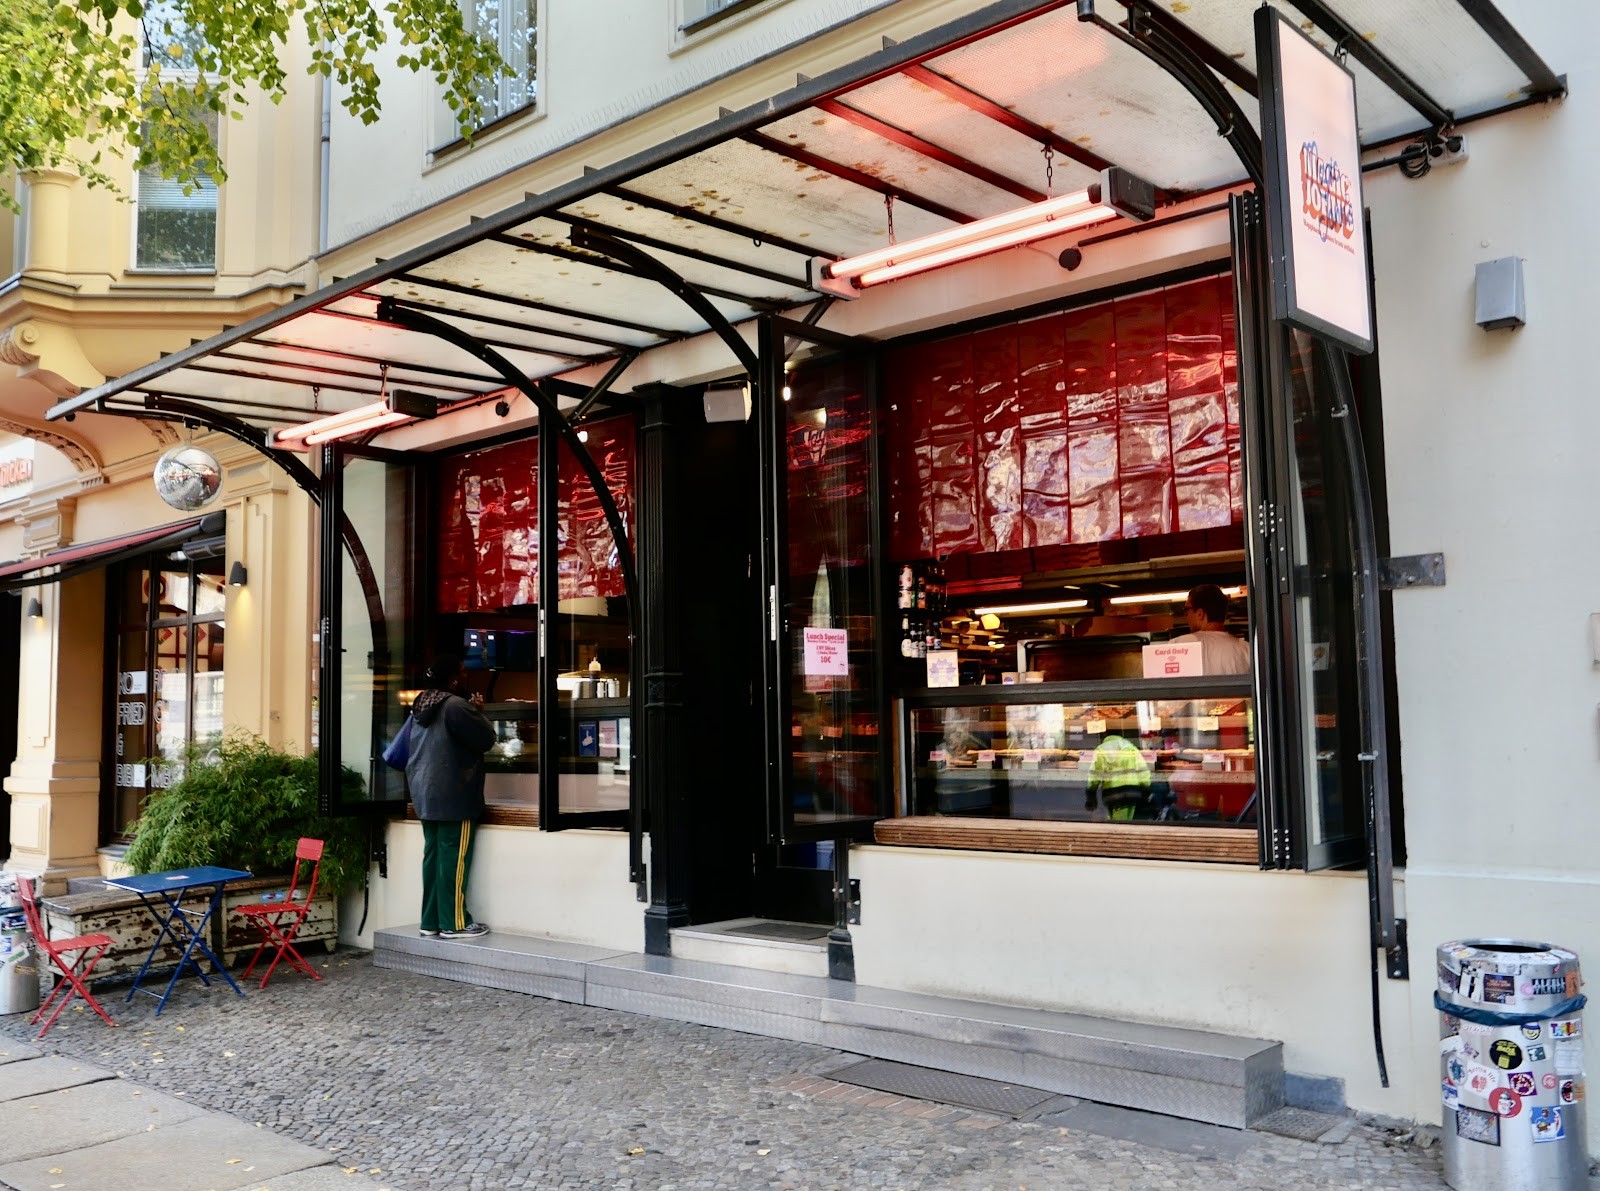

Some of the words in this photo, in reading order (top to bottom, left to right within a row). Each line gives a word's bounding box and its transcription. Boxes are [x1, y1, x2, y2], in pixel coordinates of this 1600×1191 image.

[806, 632, 823, 640] Lunch
[824, 633, 844, 641] Special
[1155, 648, 1171, 656] Card
[1172, 648, 1189, 656] Only
